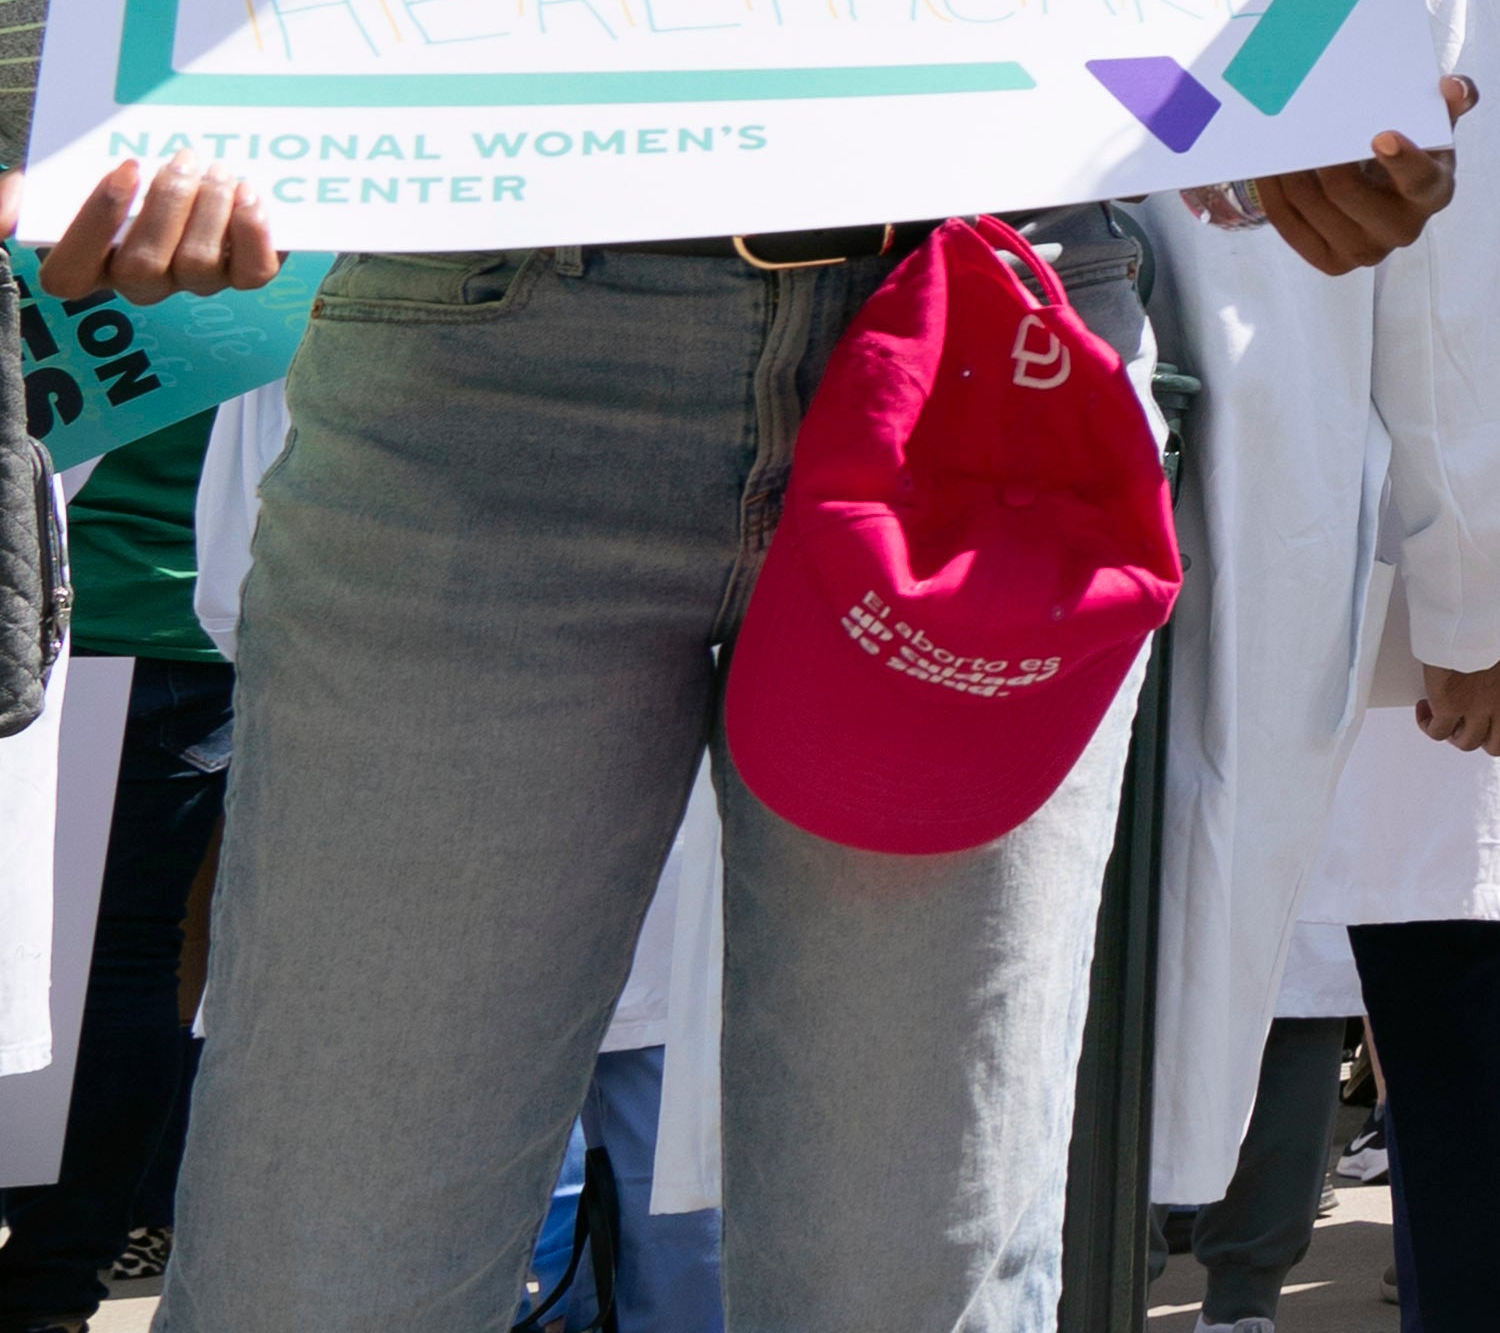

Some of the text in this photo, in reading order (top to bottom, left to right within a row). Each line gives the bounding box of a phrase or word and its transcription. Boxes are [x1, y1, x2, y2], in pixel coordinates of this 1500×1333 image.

[108, 124, 768, 162] NATIONAL WOMEN'S
[271, 175, 528, 206] CENTER
[61, 290, 162, 407] ION
[849, 605, 893, 641] un
[862, 590, 1062, 672] El aborto es
